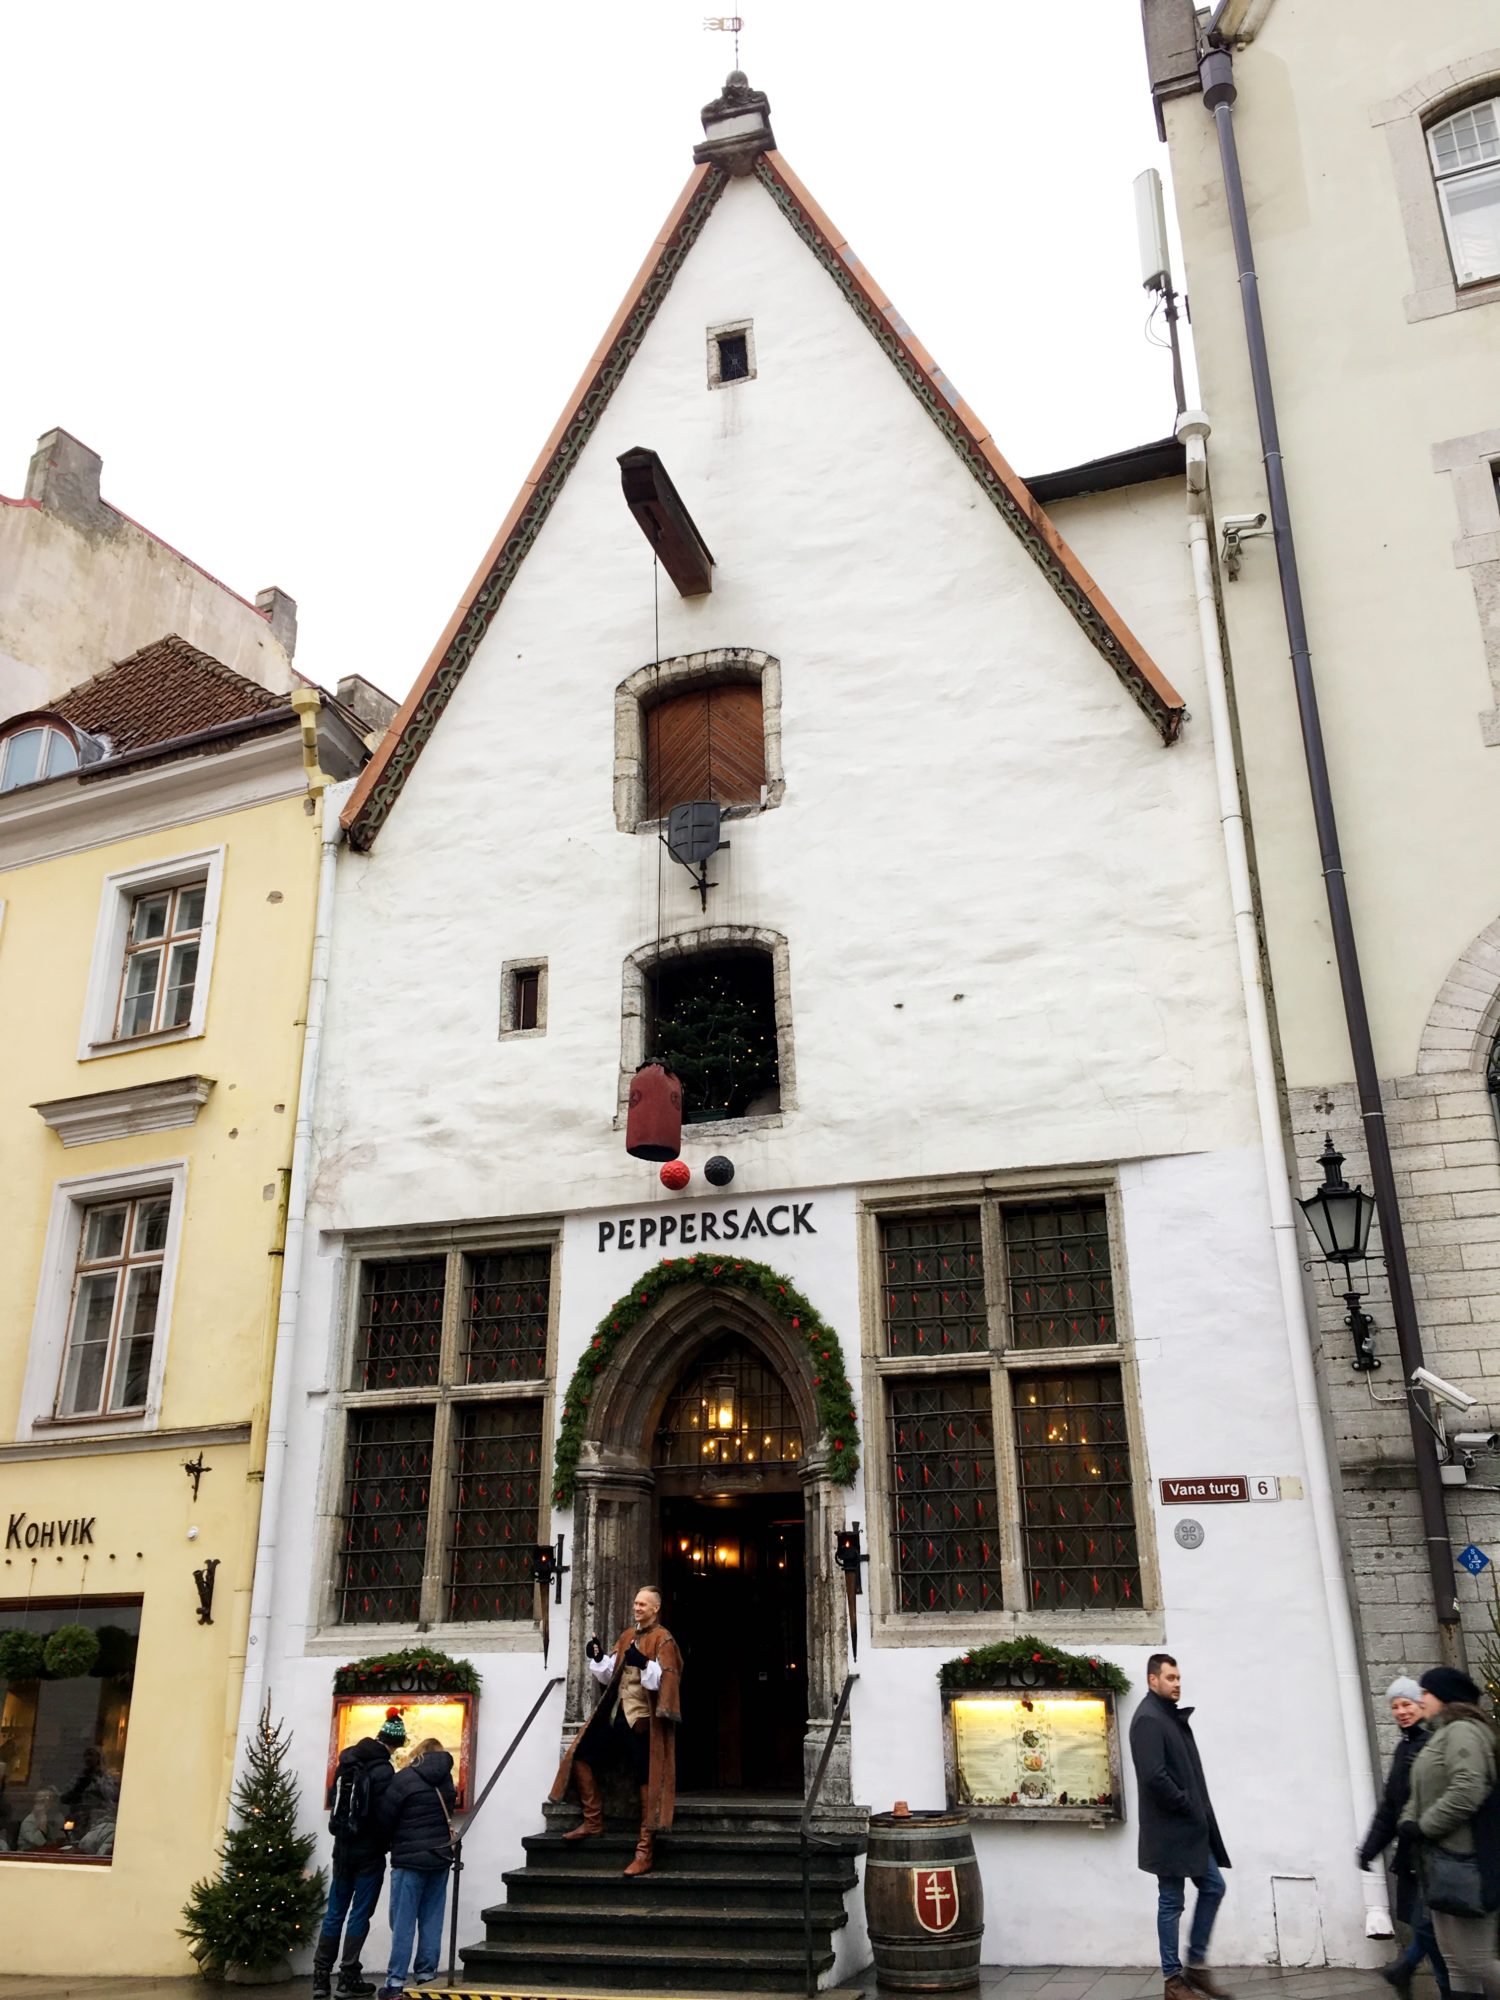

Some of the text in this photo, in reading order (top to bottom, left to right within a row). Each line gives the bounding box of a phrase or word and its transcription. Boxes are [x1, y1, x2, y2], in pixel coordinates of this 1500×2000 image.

[598, 1202, 817, 1252] PEPPERSACK
[1169, 1482, 1240, 1496] Vana turg
[1257, 1481, 1268, 1495] 6
[5, 1512, 96, 1549] KOHVIK
